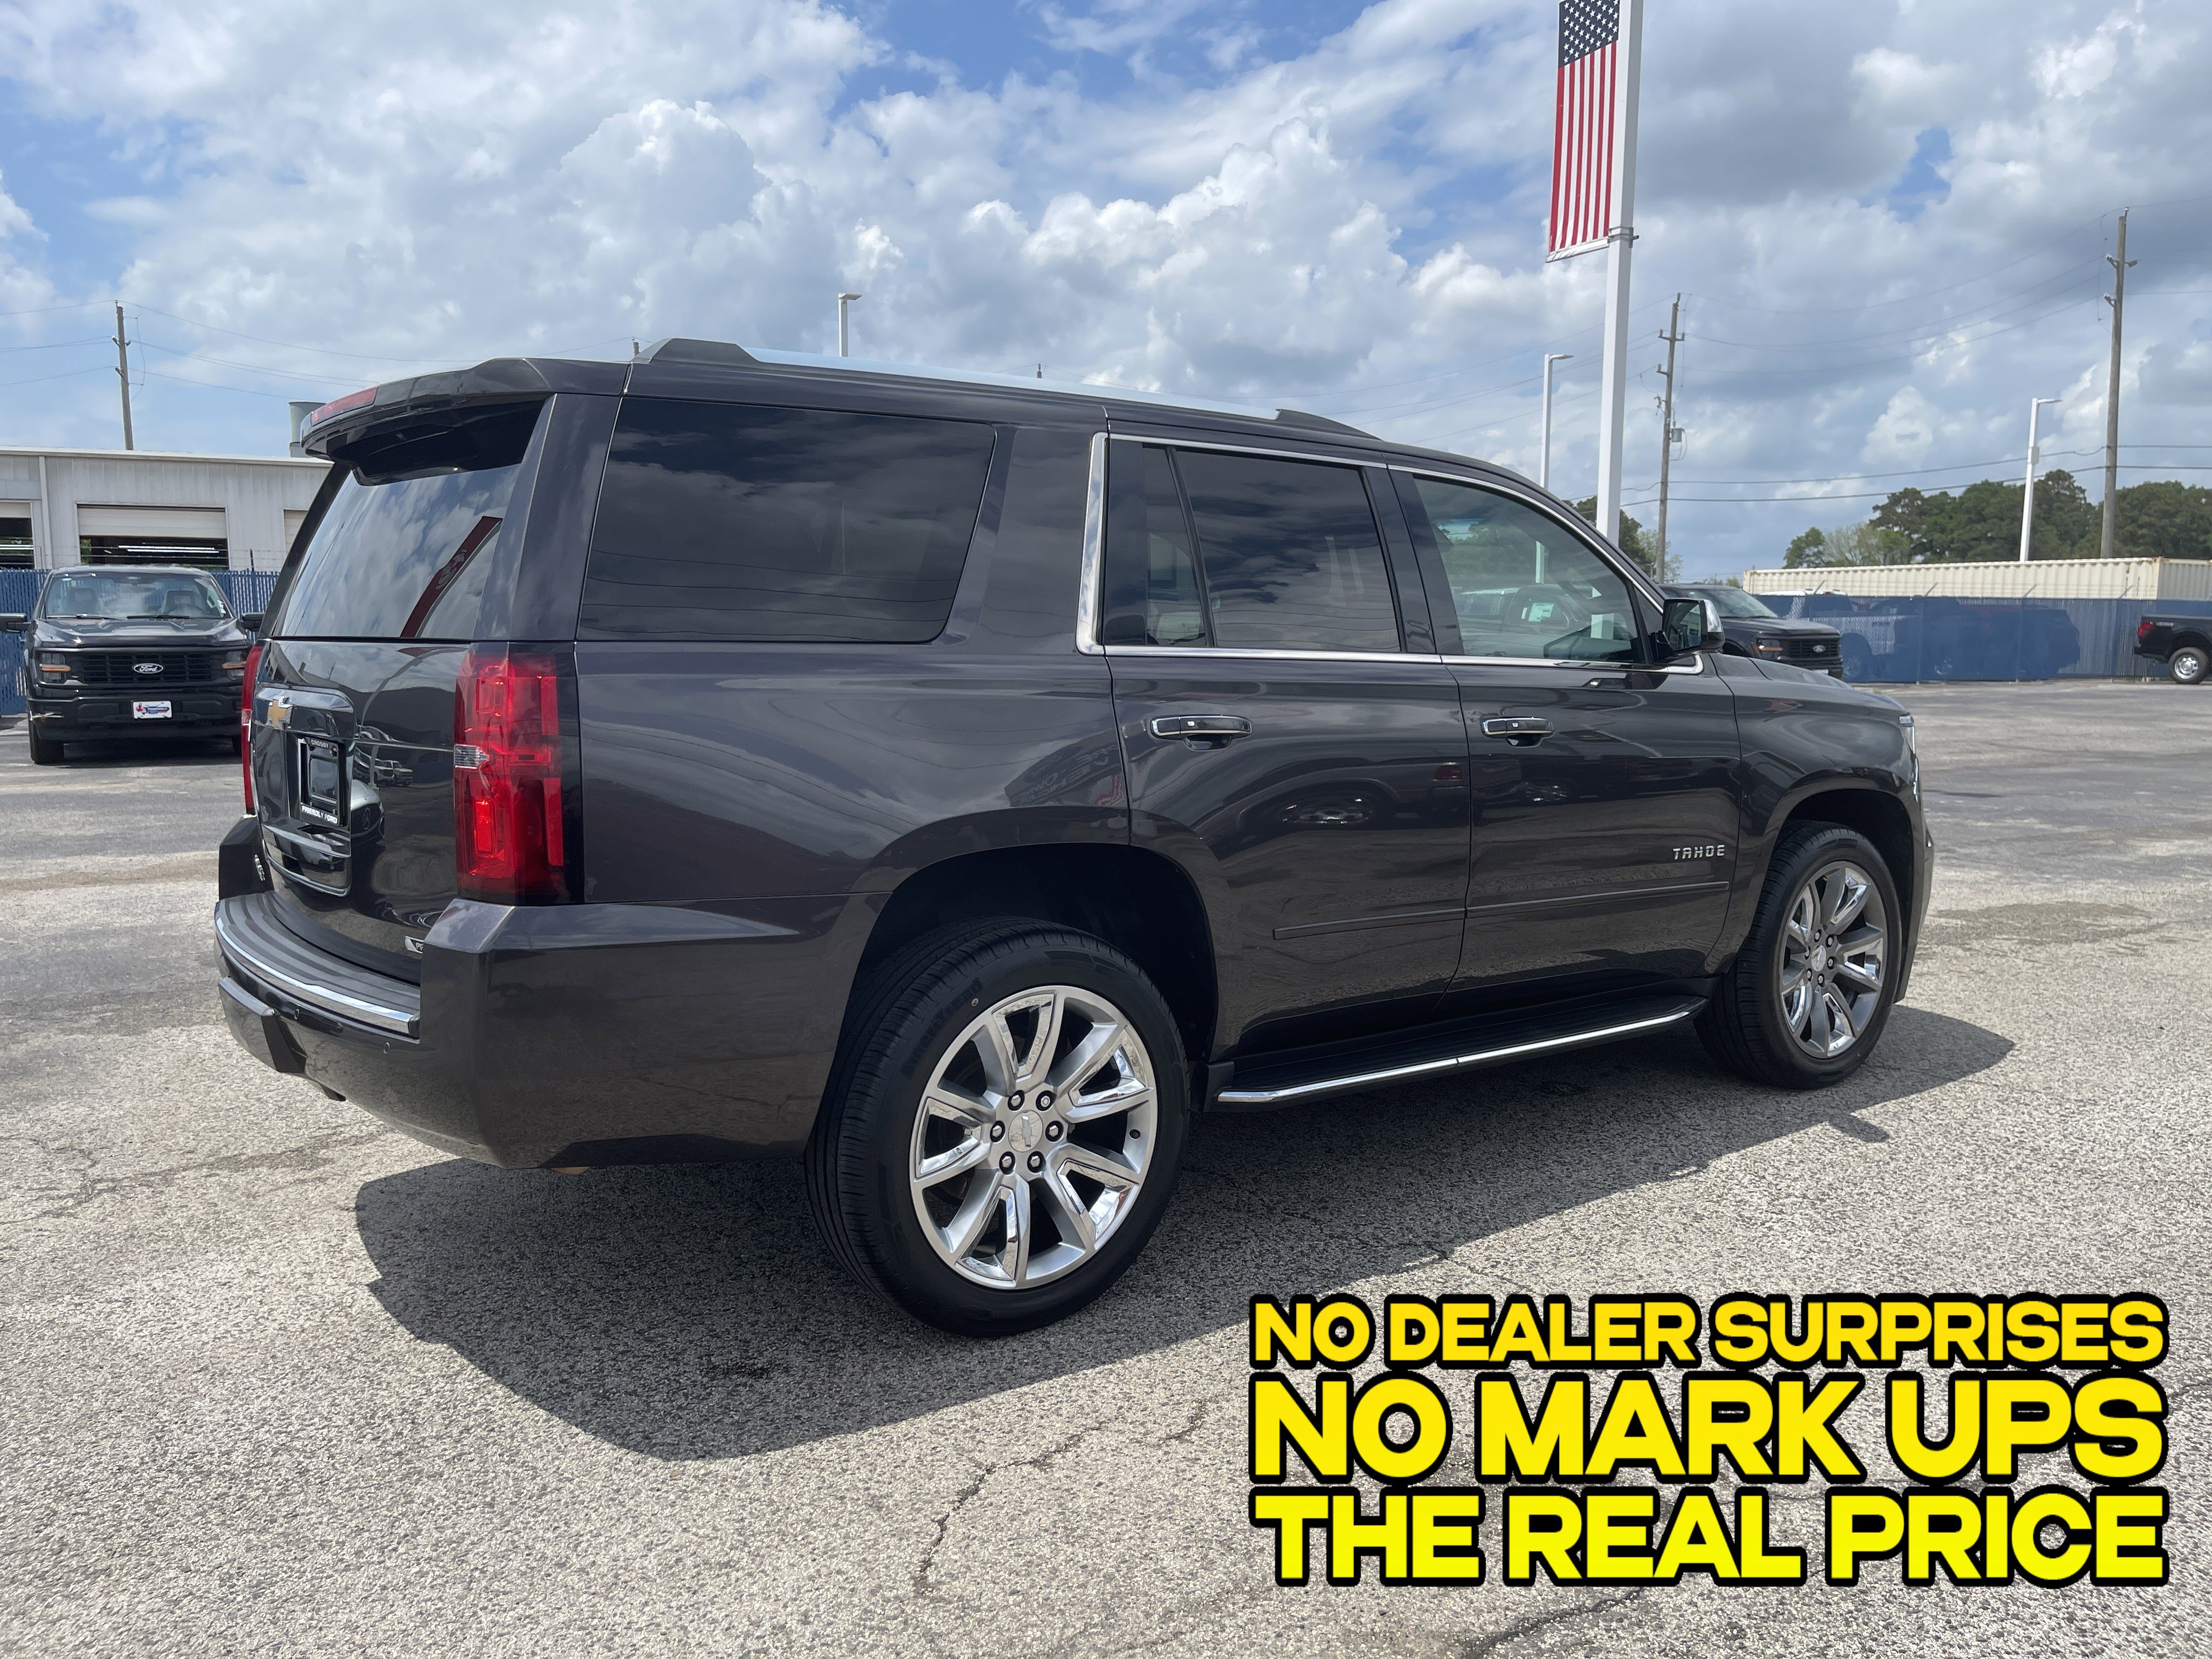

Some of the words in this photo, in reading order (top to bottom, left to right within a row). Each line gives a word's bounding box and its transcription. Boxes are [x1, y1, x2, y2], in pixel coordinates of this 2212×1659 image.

[311, 739, 329, 748] CROSBY
[302, 805, 324, 819] FRIENDLY
[324, 814, 337, 824] FORD
[1673, 845, 1725, 860] TAHOE
